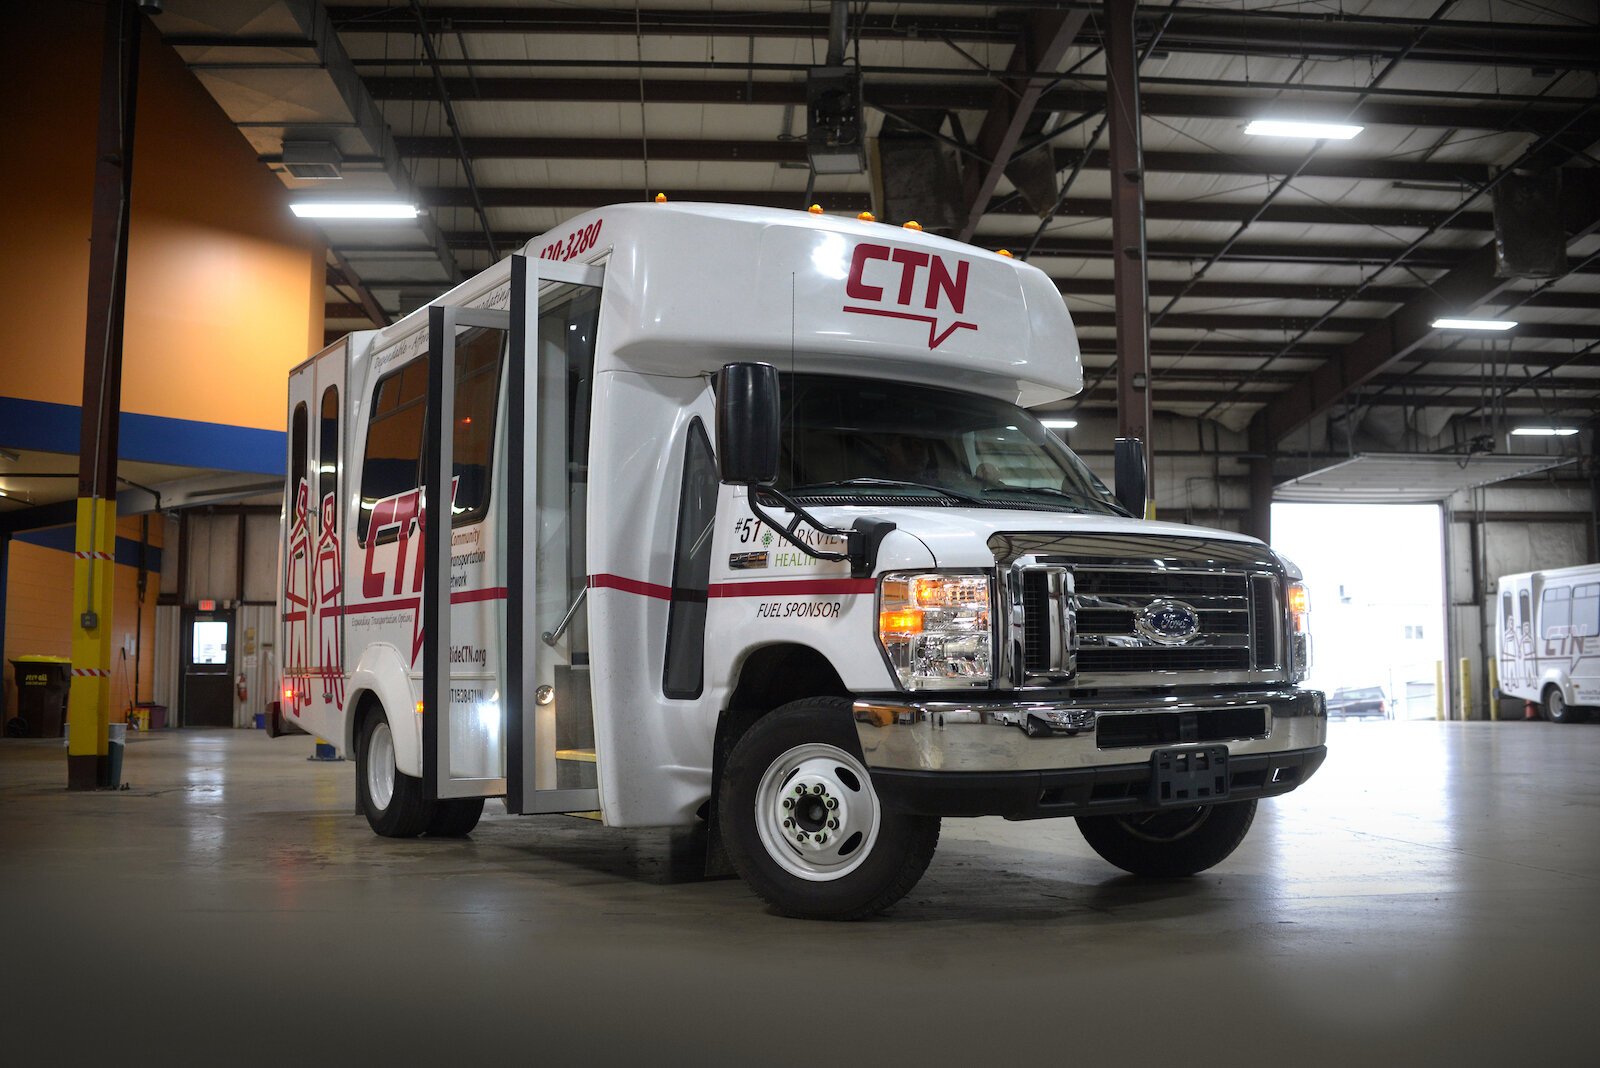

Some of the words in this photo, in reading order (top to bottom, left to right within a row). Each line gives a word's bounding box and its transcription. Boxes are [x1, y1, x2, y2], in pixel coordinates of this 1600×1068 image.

[846, 243, 970, 314] CTN
[734, 518, 762, 543] #51
[450, 548, 486, 570] ransportation
[450, 570, 467, 588] etwork
[757, 603, 781, 618] FUEL
[783, 602, 841, 618] SPONSOR
[1544, 623, 1588, 656] CTN
